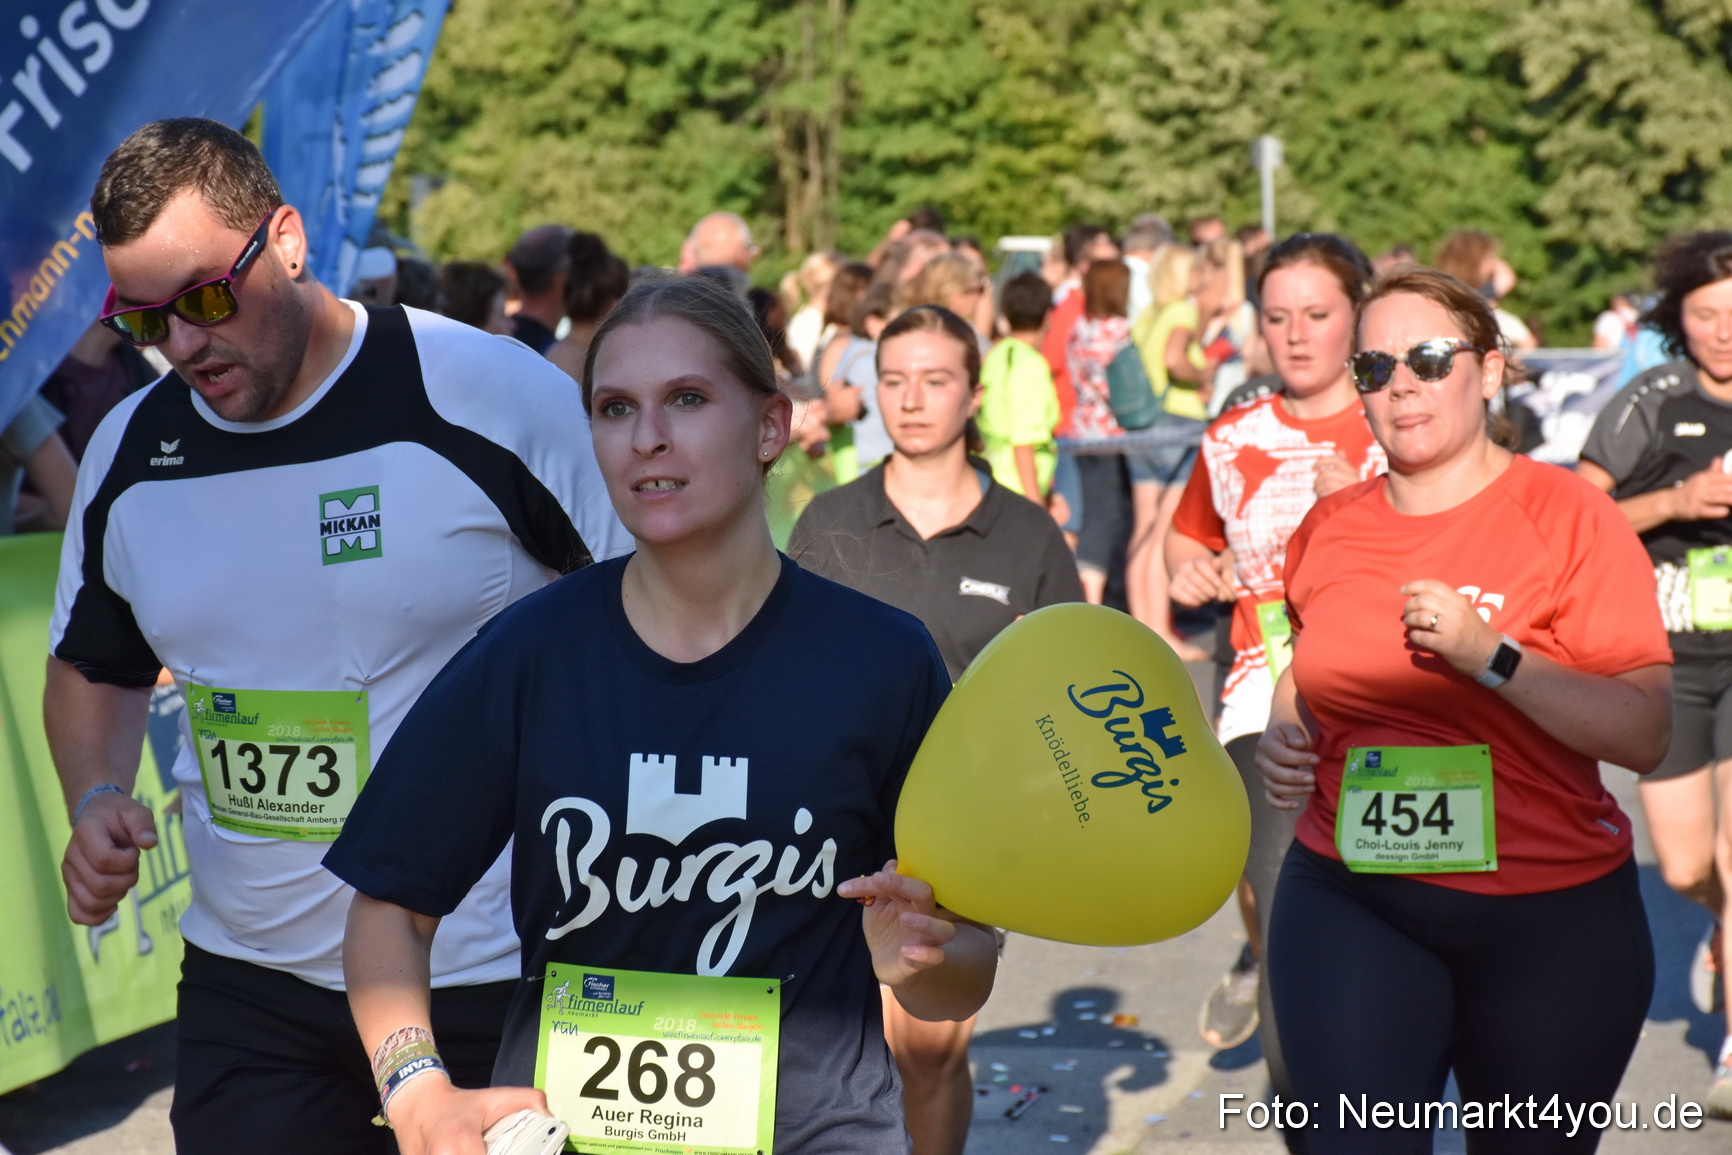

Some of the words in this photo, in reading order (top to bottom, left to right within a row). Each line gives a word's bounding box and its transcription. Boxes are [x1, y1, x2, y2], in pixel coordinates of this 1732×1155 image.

[150, 456, 184, 466] erima
[320, 514, 381, 536] MICKAN
[205, 709, 260, 725] firmenlauf
[267, 725, 300, 737] 2018
[1067, 669, 1179, 814] Burgis
[211, 739, 341, 798] 1373
[1035, 714, 1091, 828] Knödelliebe.
[228, 794, 254, 809] Hußl
[257, 798, 325, 814] Alexander
[228, 808, 305, 823] General-Bau-Gesellschaft
[307, 816, 338, 825] Amberg
[1361, 792, 1455, 837] 454
[1355, 838, 1421, 850] Choi-Louis
[1424, 840, 1464, 852] Jenny
[1375, 853, 1409, 862] dessign
[1411, 853, 1439, 861] GmbH
[540, 796, 838, 977] Burgis
[568, 995, 645, 1016] firmenlauf
[653, 1016, 697, 1032] 2018
[579, 1035, 716, 1108] 268
[591, 1105, 634, 1122] Auer
[640, 1109, 703, 1129] Regina
[605, 1126, 643, 1140] Burgis
[648, 1129, 686, 1142] GmbH
